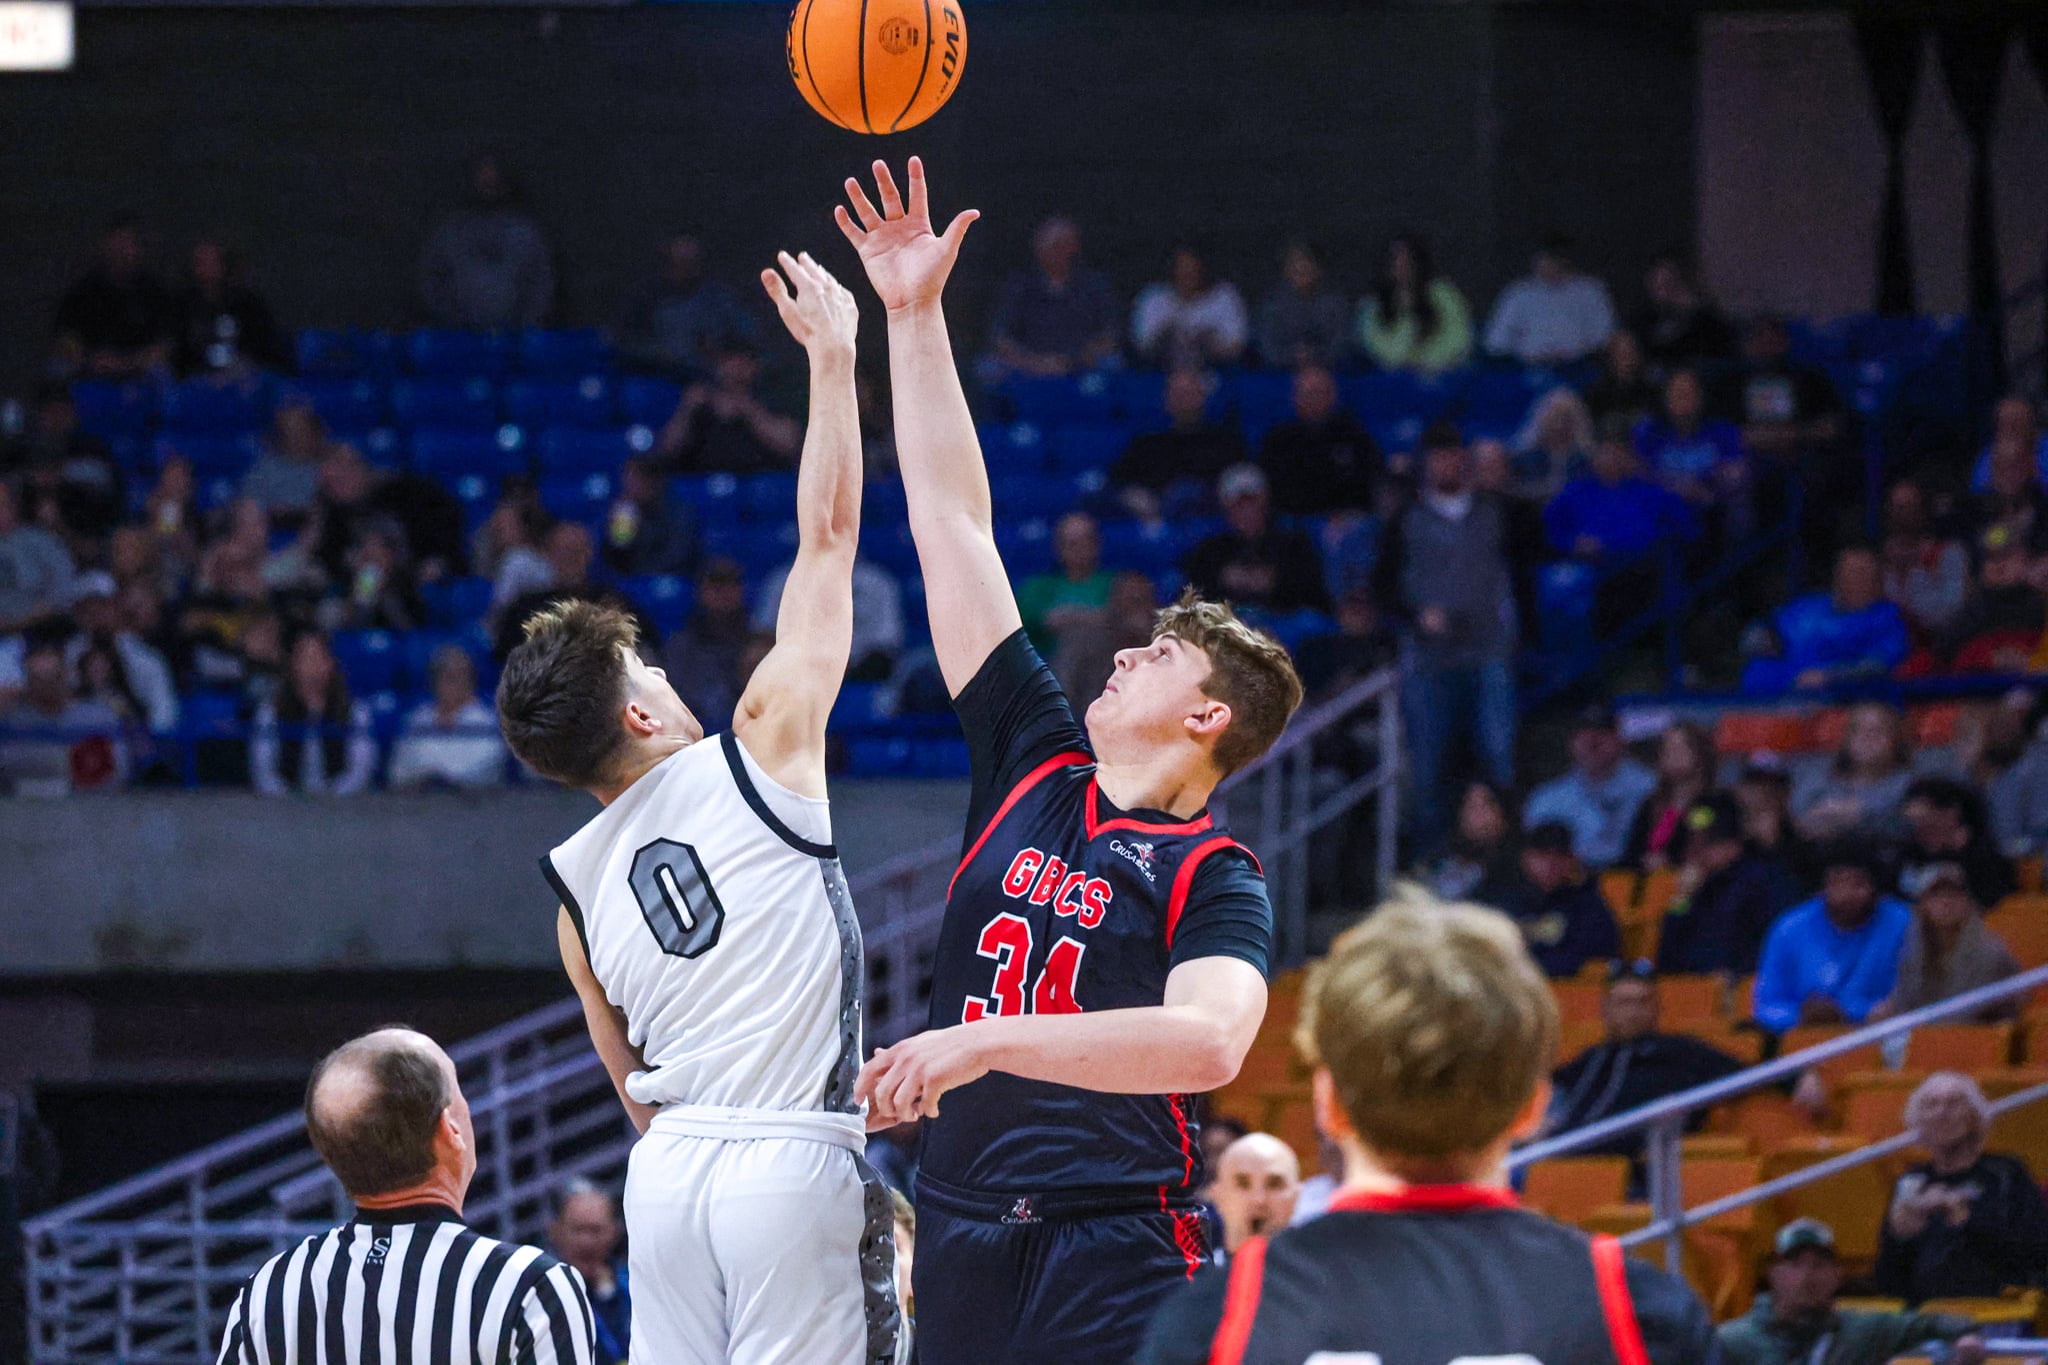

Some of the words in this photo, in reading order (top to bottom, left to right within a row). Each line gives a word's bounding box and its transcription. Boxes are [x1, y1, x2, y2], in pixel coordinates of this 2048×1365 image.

[942, 6, 960, 80] EVO
[627, 837, 726, 960] 0
[1002, 847, 1113, 930] GBCS
[962, 911, 1087, 1024] 34
